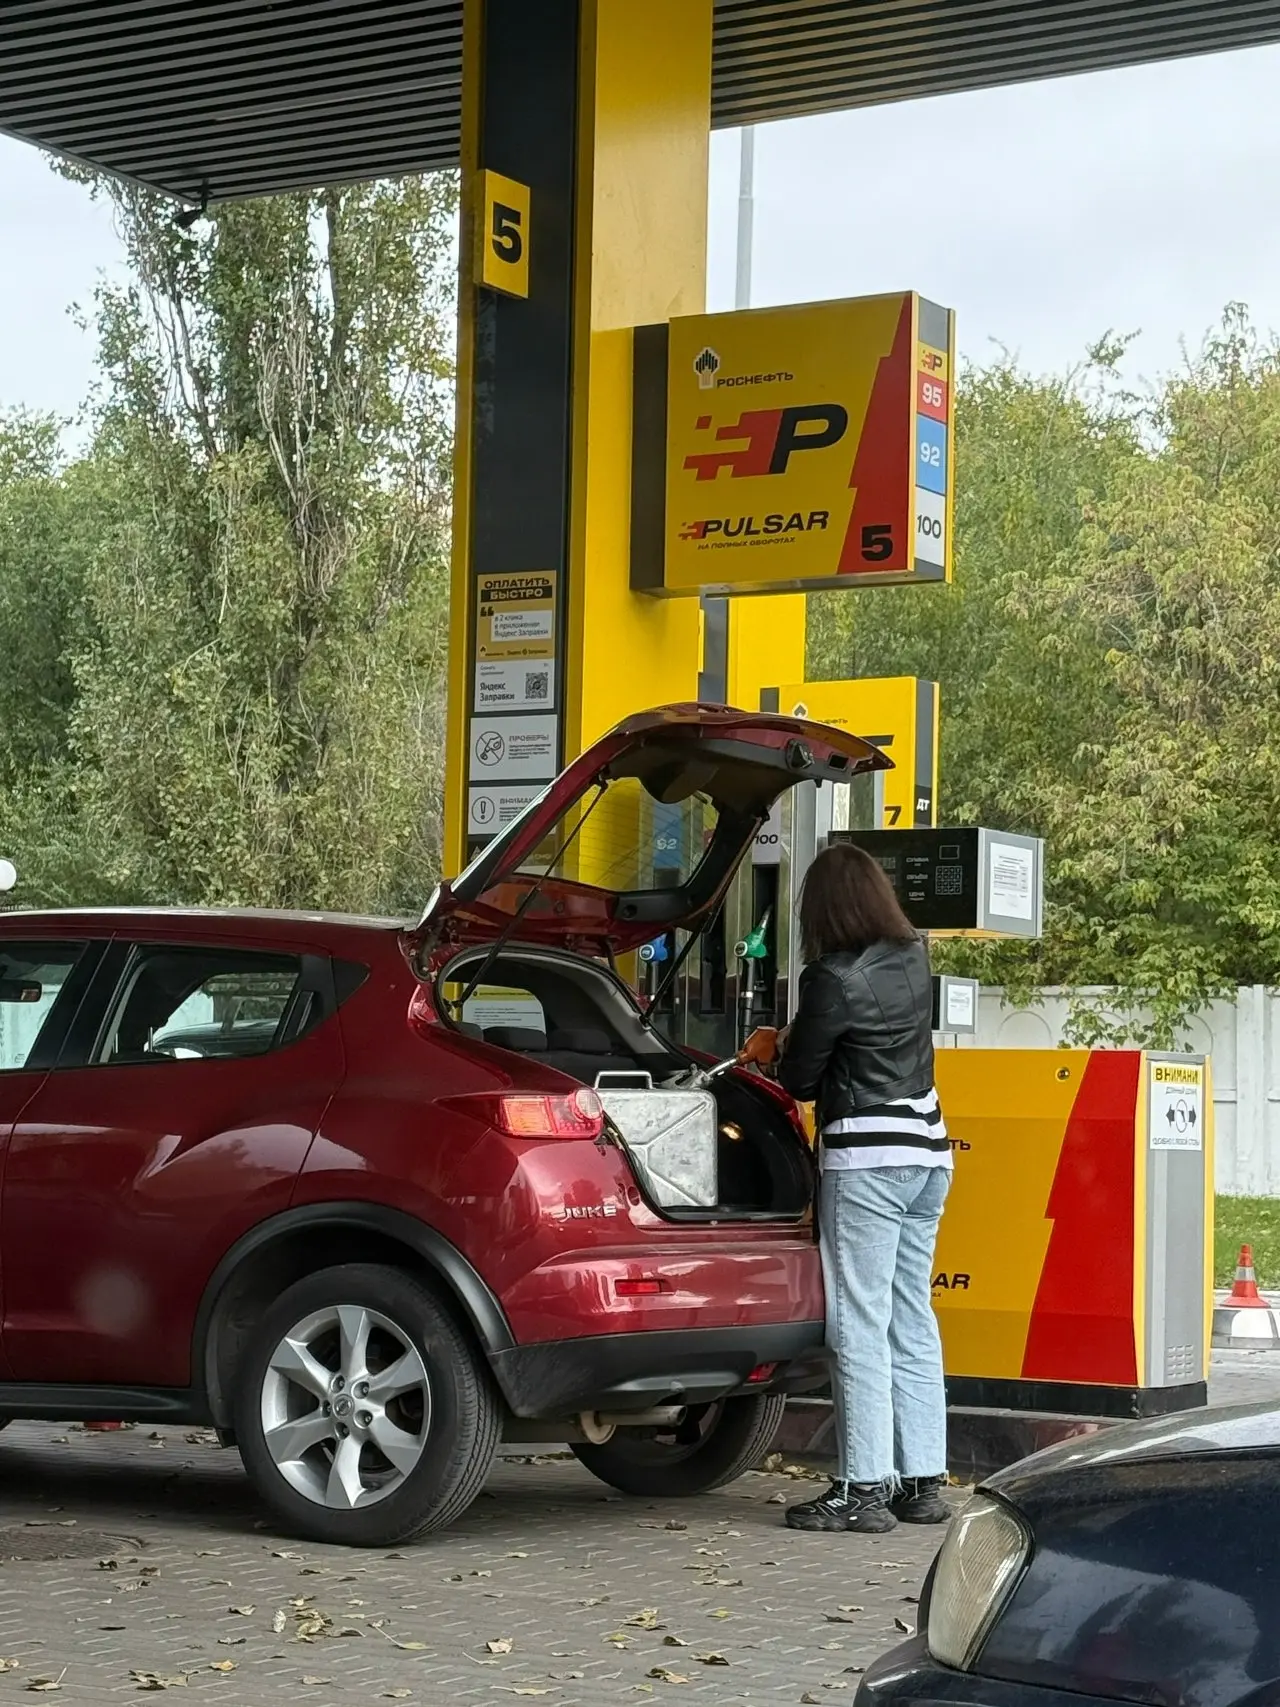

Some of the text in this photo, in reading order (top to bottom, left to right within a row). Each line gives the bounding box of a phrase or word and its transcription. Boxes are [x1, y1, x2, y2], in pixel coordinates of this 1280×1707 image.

[491, 201, 523, 265] 5
[716, 372, 794, 389] РОСНЕФТЬ
[921, 382, 942, 408] 95
[920, 442, 940, 468] 92
[701, 511, 829, 539] PULSAR
[916, 514, 942, 540] 100
[711, 540, 748, 549] ПОЛНЫХ
[749, 536, 796, 547] ОБОРОТАХ
[860, 524, 894, 562] 5
[484, 577, 550, 590] ОПЛАТИТЬ
[490, 588, 544, 600] БЫСТРО
[480, 682, 506, 692] Яндекс
[480, 692, 515, 703] Заправки
[916, 798, 930, 811] ДТ
[883, 805, 902, 826] 7
[656, 838, 678, 850] 92
[755, 834, 779, 845] 100
[1155, 1067, 1199, 1084] ВНИМАНИ
[558, 1205, 617, 1223] JUKE
